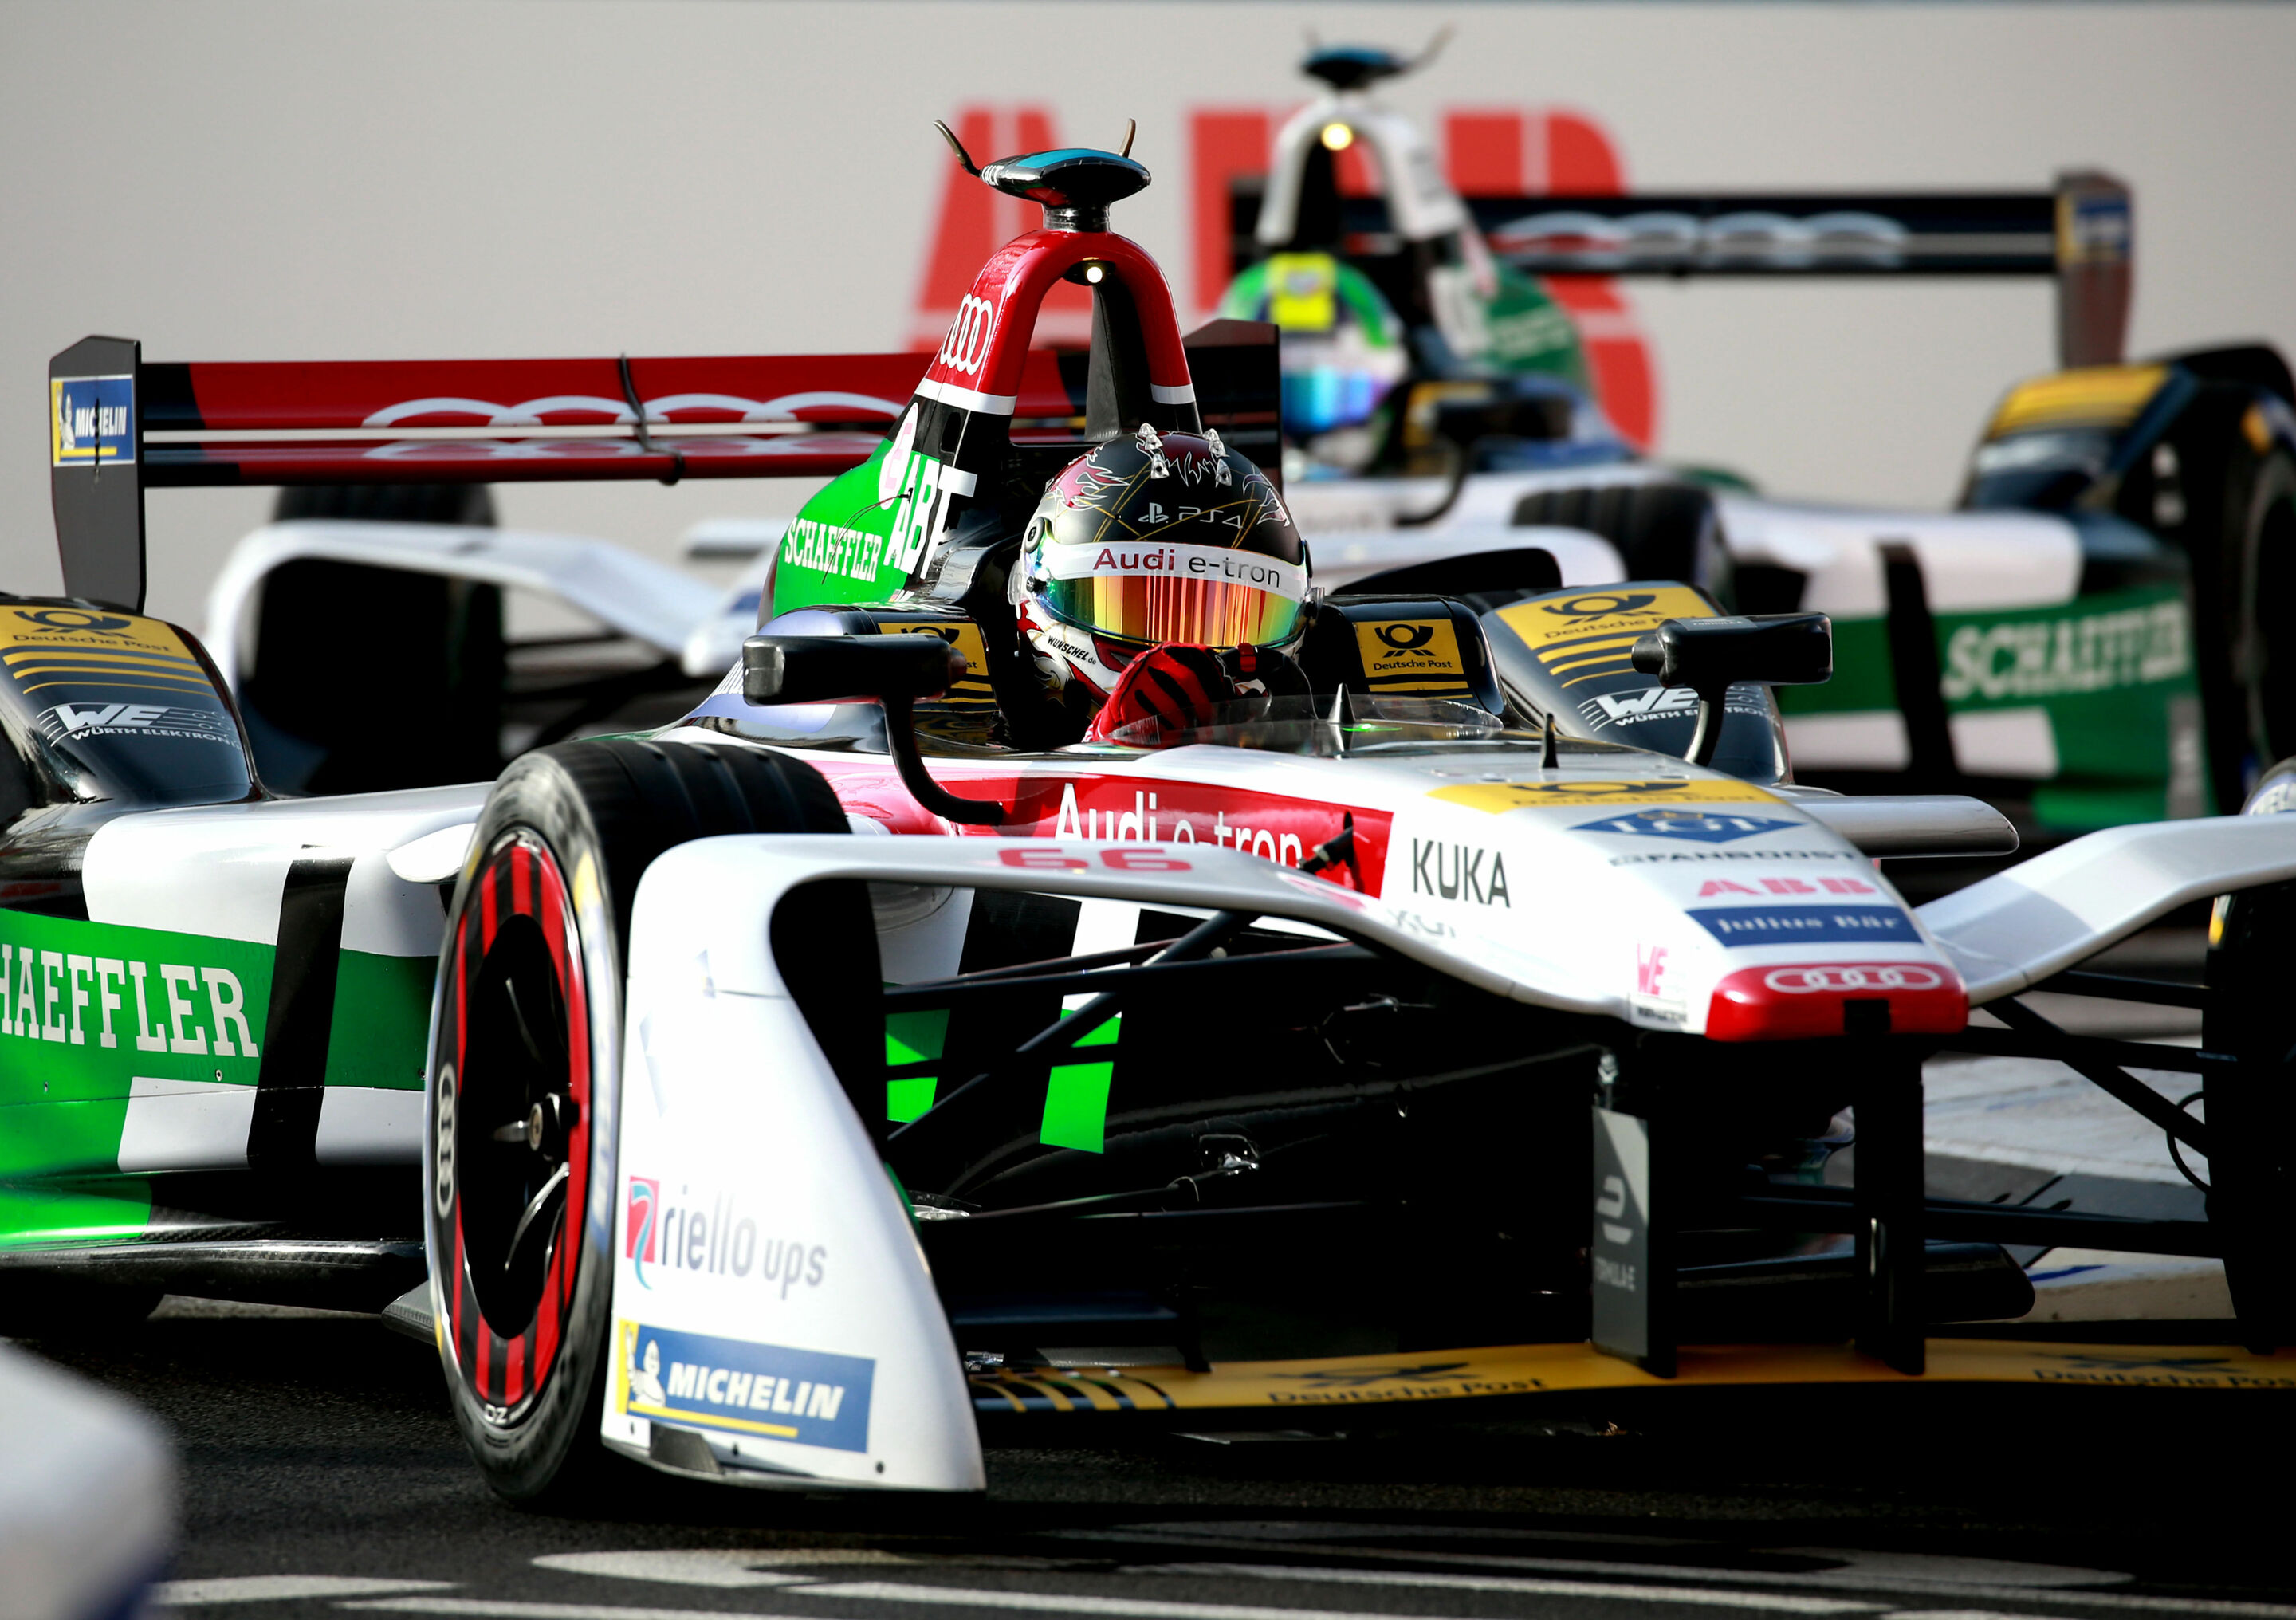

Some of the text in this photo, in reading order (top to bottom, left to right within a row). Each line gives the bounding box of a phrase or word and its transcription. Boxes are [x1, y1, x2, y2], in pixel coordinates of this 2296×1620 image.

[883, 454, 978, 580] ABT
[784, 517, 883, 583] SCHAEFFLER
[1093, 548, 1280, 588] Audi e-tron
[1543, 617, 1648, 639] Deutsche
[12, 634, 173, 653] Deutsche Post
[1373, 659, 1426, 671] Deutsche
[54, 703, 171, 731] WE
[1616, 708, 1681, 726] WÜRTH
[71, 726, 137, 741] WÜRTH
[1054, 783, 1158, 843] Audi
[1413, 837, 1512, 909] KUKA
[1698, 877, 1877, 898] ABB
[1716, 914, 1901, 934] Julius Bär
[662, 1184, 828, 1301] riello ups
[666, 1361, 847, 1421] MICHELIN
